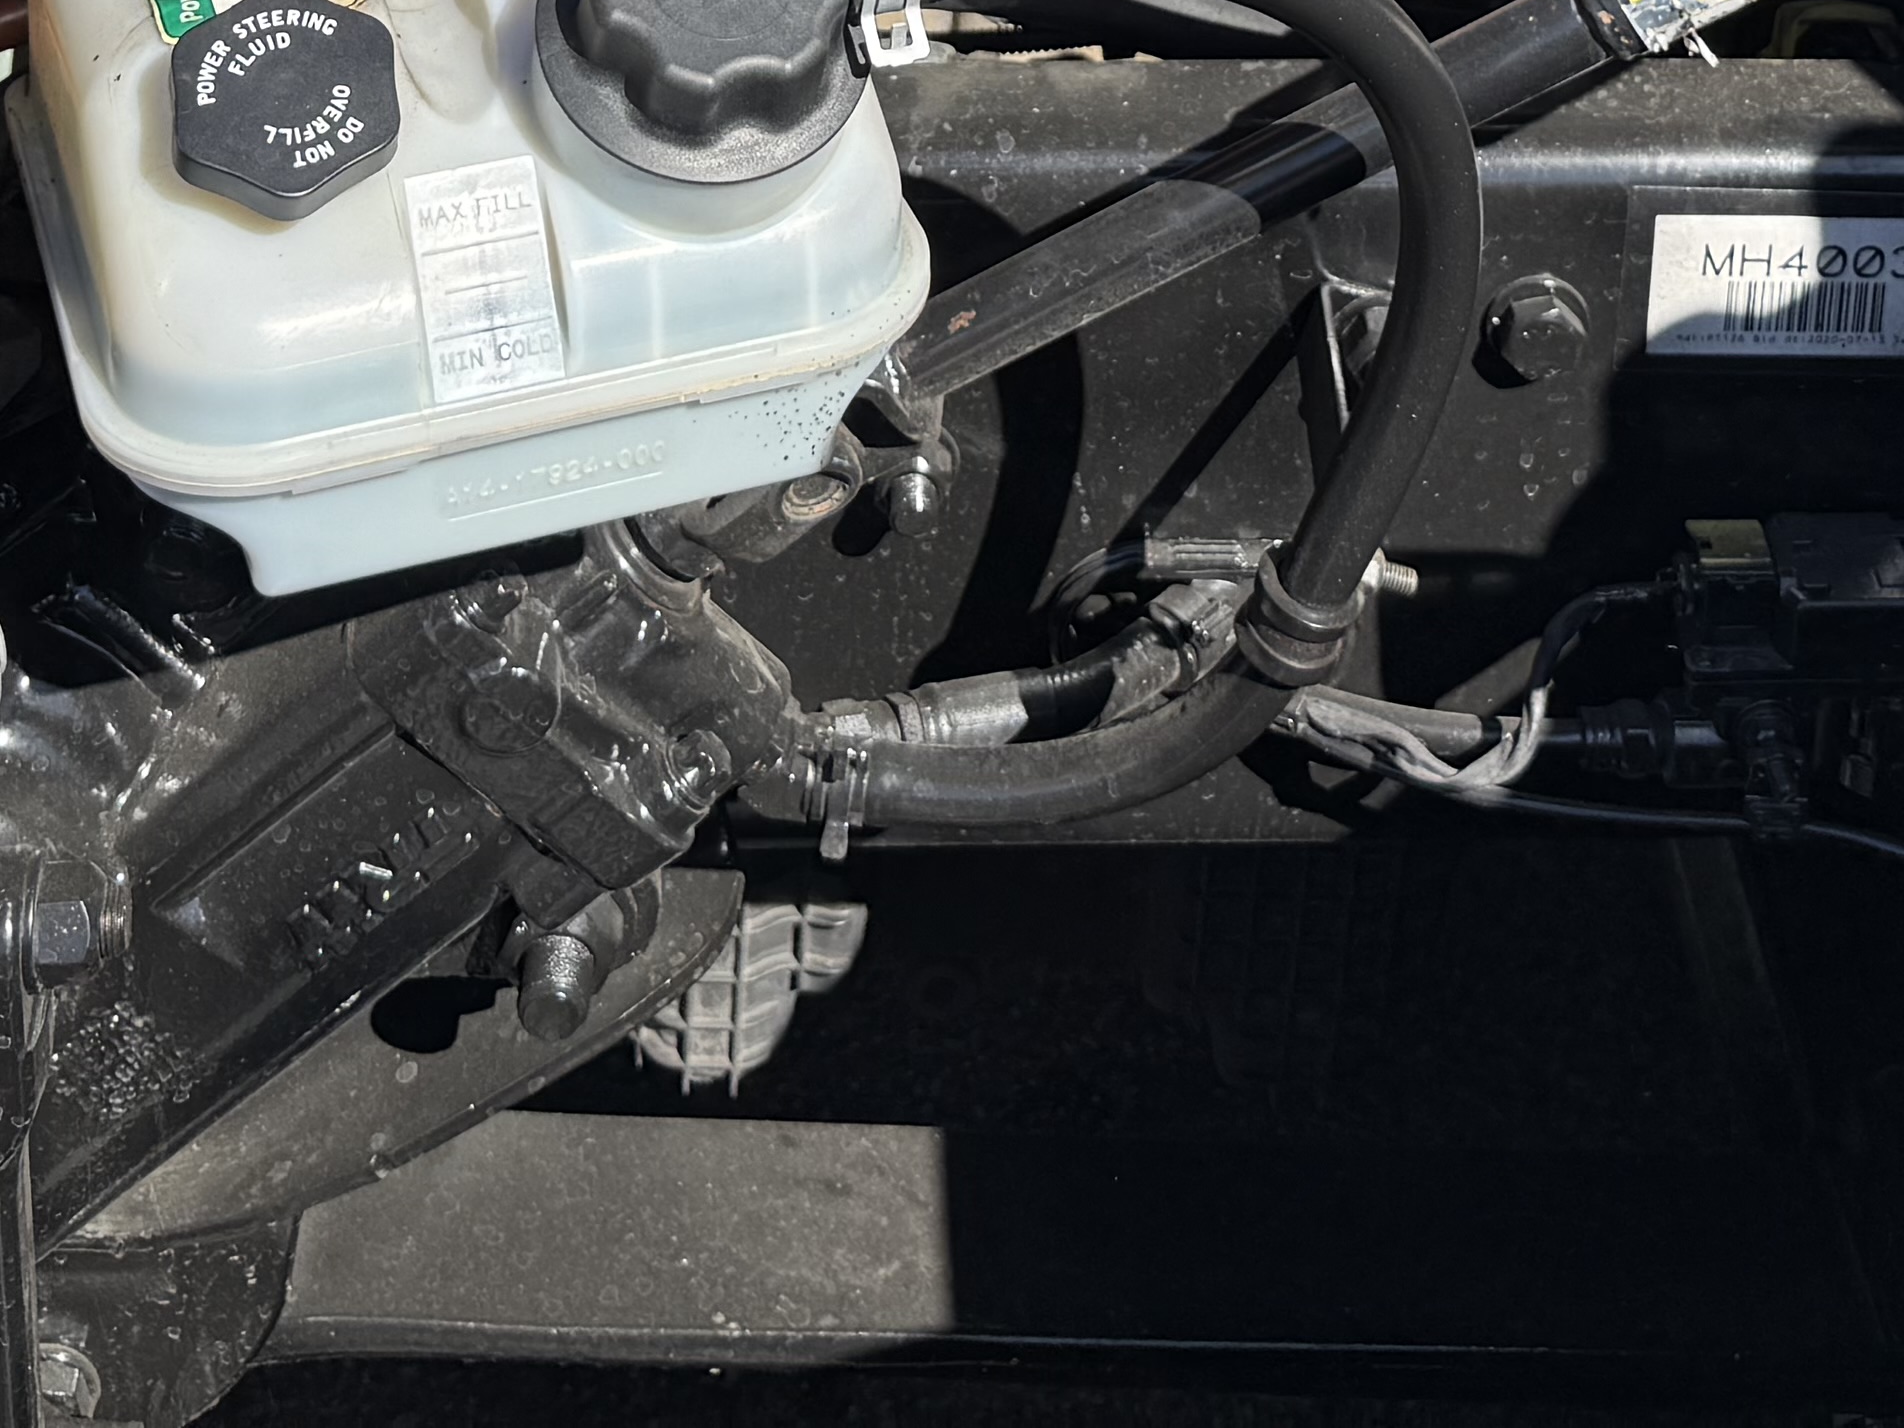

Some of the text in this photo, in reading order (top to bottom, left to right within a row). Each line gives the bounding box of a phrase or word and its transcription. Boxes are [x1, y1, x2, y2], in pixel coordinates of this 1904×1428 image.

[196, 9, 338, 106] POWER STEERING
[227, 31, 291, 76] FLUID
[263, 84, 352, 146] OVERFILL
[293, 116, 365, 168] DO NOT
[419, 201, 468, 228] MAX
[440, 332, 554, 375] MIN COLD
